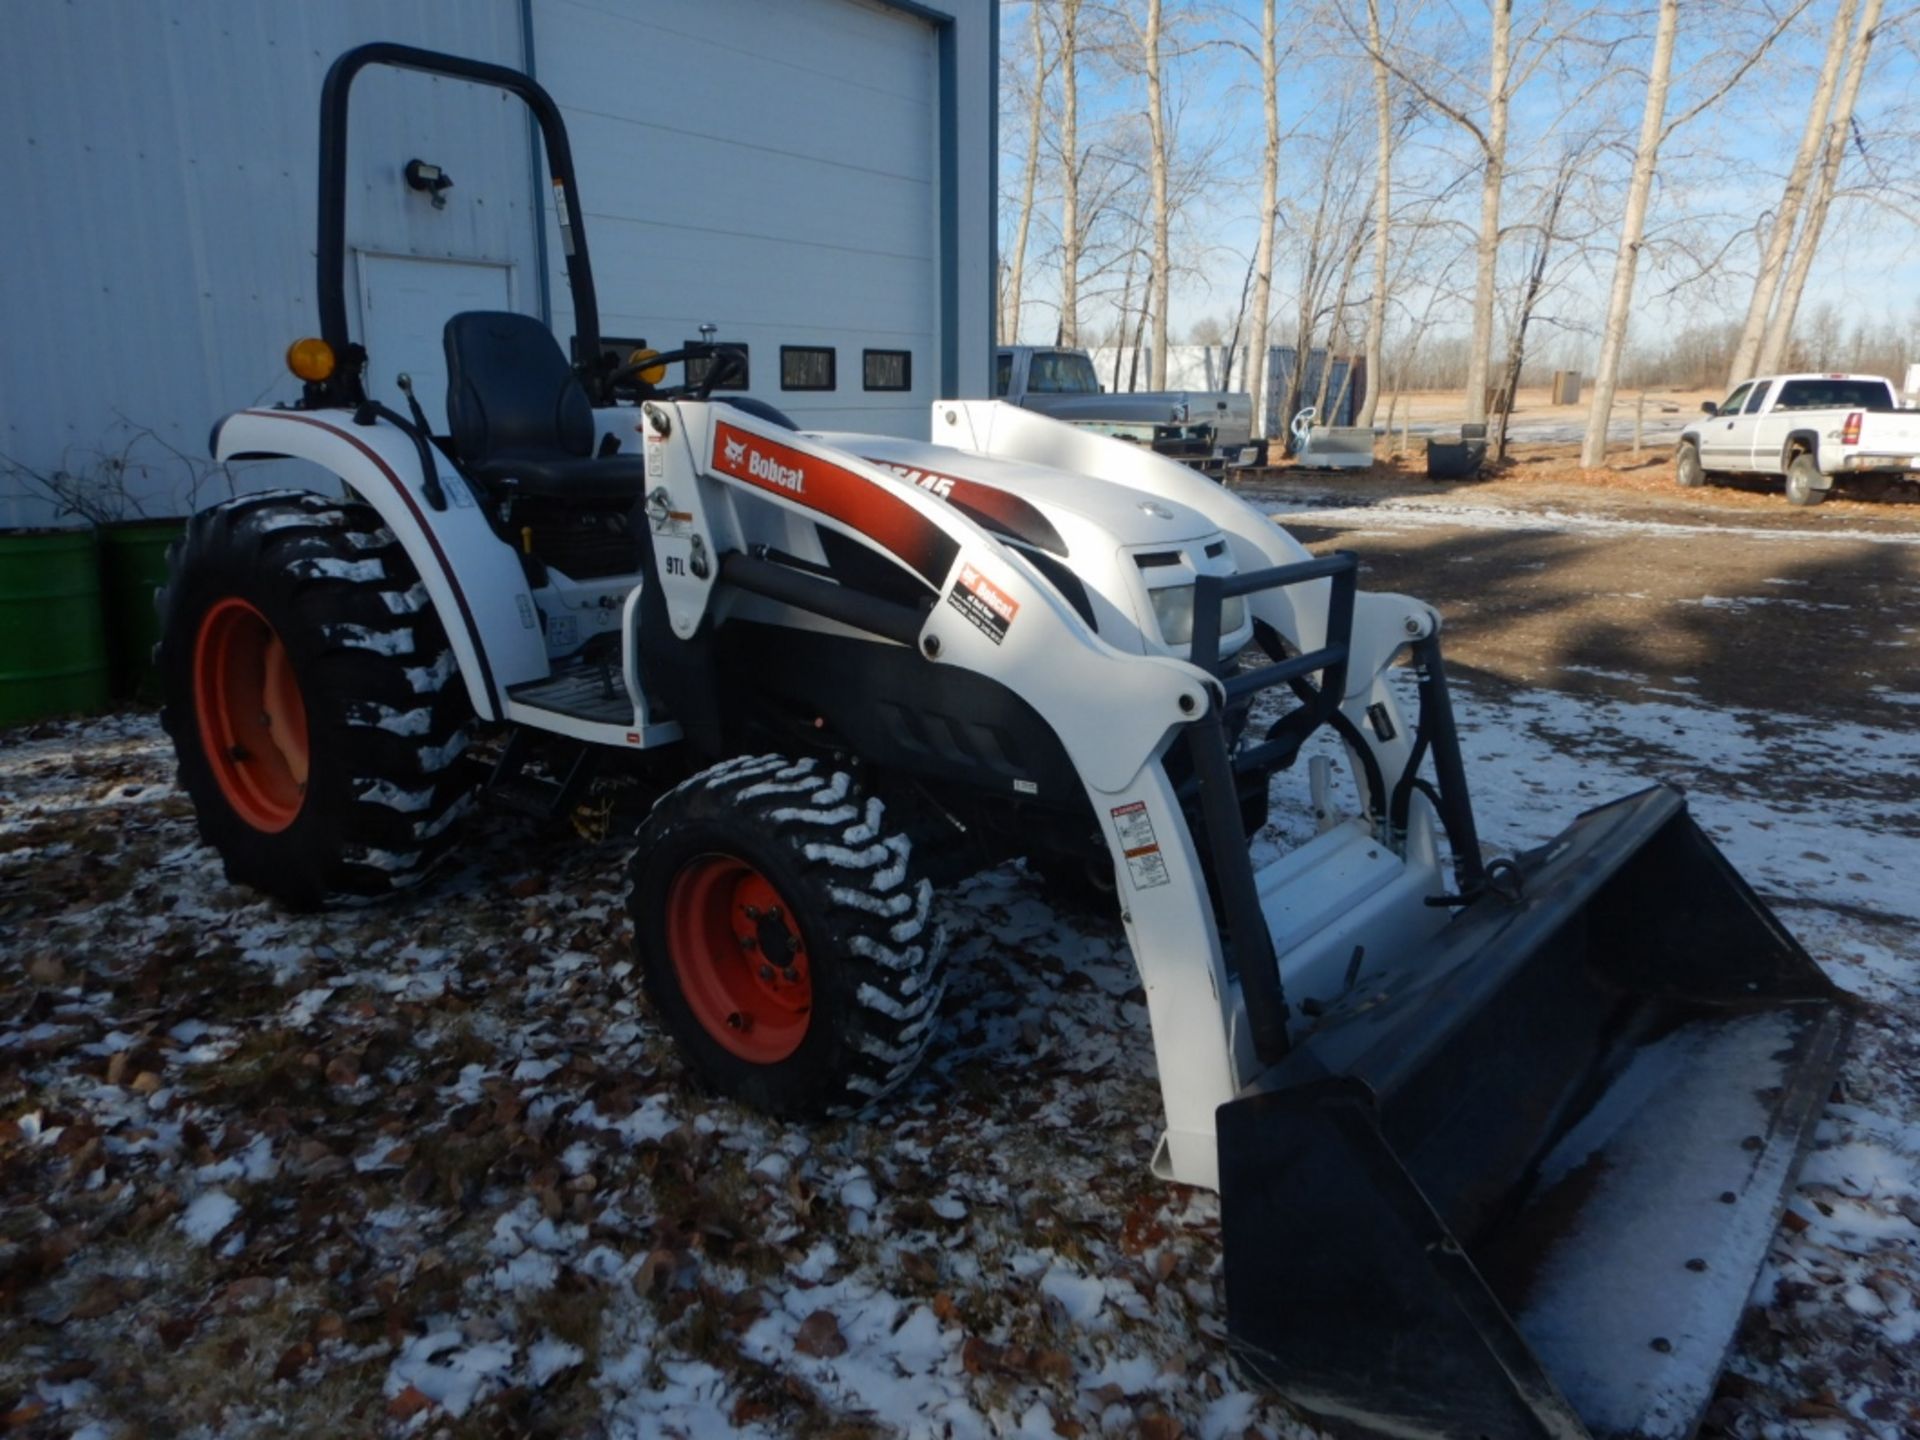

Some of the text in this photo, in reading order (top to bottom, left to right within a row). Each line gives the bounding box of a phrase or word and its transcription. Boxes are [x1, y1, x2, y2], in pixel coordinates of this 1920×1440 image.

[748, 450, 804, 493] Bobcat
[666, 555, 685, 576] 9TL
[975, 581, 1013, 620] Bobcat
